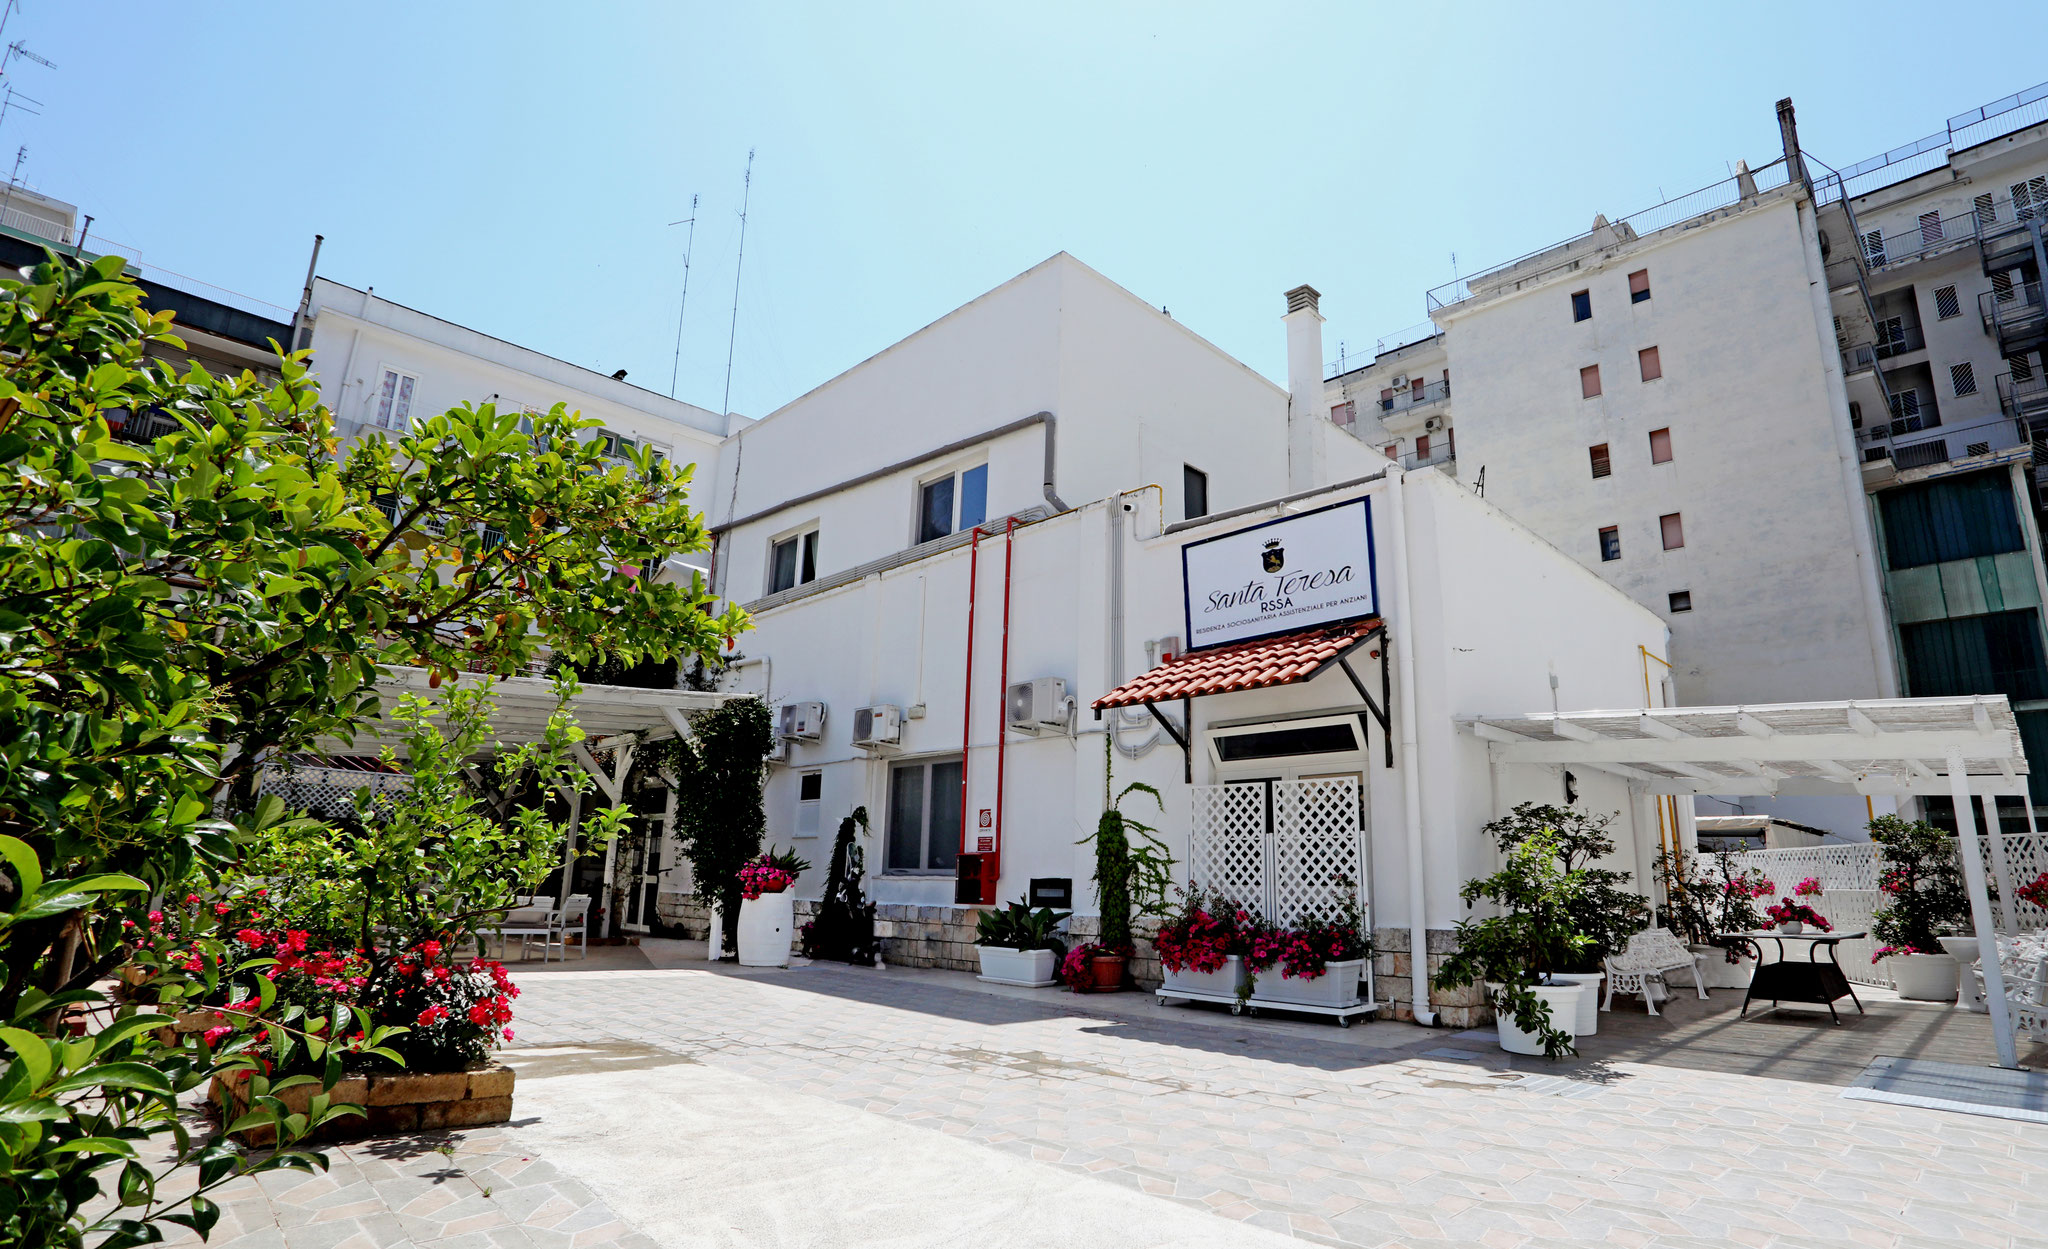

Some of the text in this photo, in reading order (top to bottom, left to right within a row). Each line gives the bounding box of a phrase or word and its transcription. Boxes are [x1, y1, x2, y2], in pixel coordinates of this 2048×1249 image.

[1204, 565, 1356, 614] Santa Teresa
[1261, 597, 1293, 613] RSSA
[1196, 595, 1367, 634] RESIDENZA SOCIOSANITARIA ASSISTENZIALE PER ANZIANI
